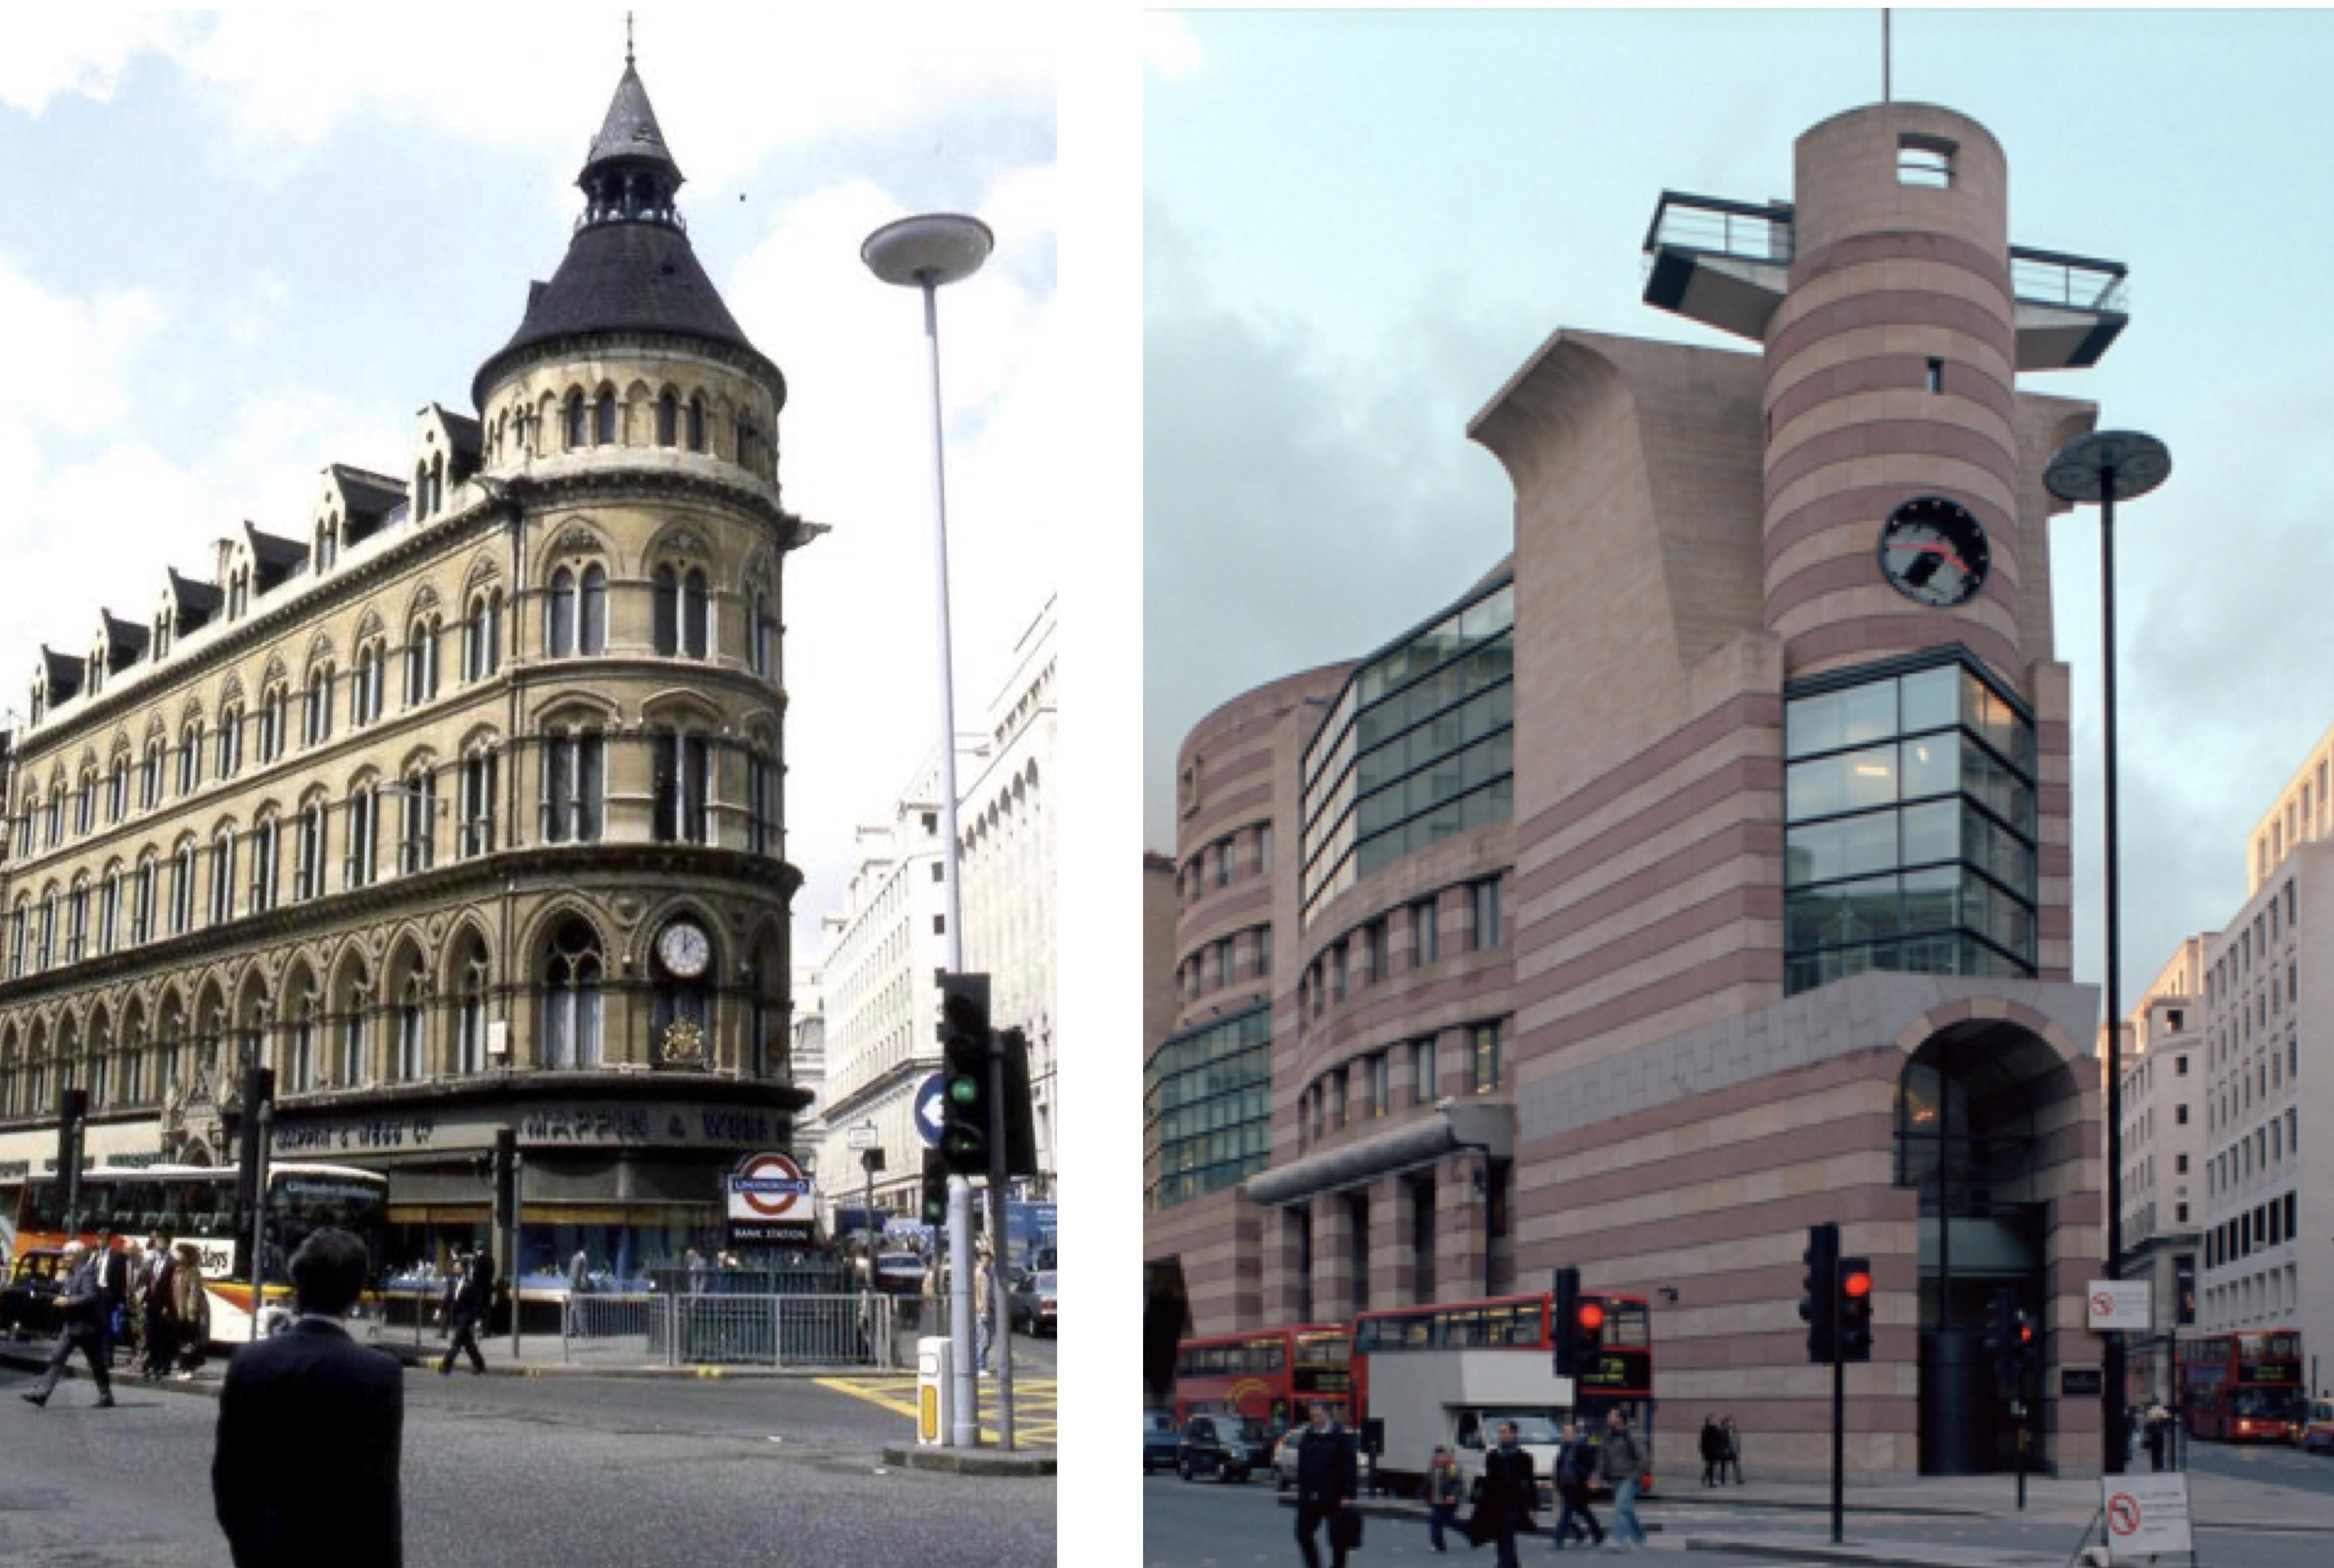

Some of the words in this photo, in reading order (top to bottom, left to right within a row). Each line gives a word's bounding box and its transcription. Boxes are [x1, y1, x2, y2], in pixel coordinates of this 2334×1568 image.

[522, 1109, 648, 1140] MAPPIN
[735, 1180, 806, 1192] UNDERGROUND
[734, 1228, 761, 1238] BANK
[767, 1228, 807, 1239] STATION
